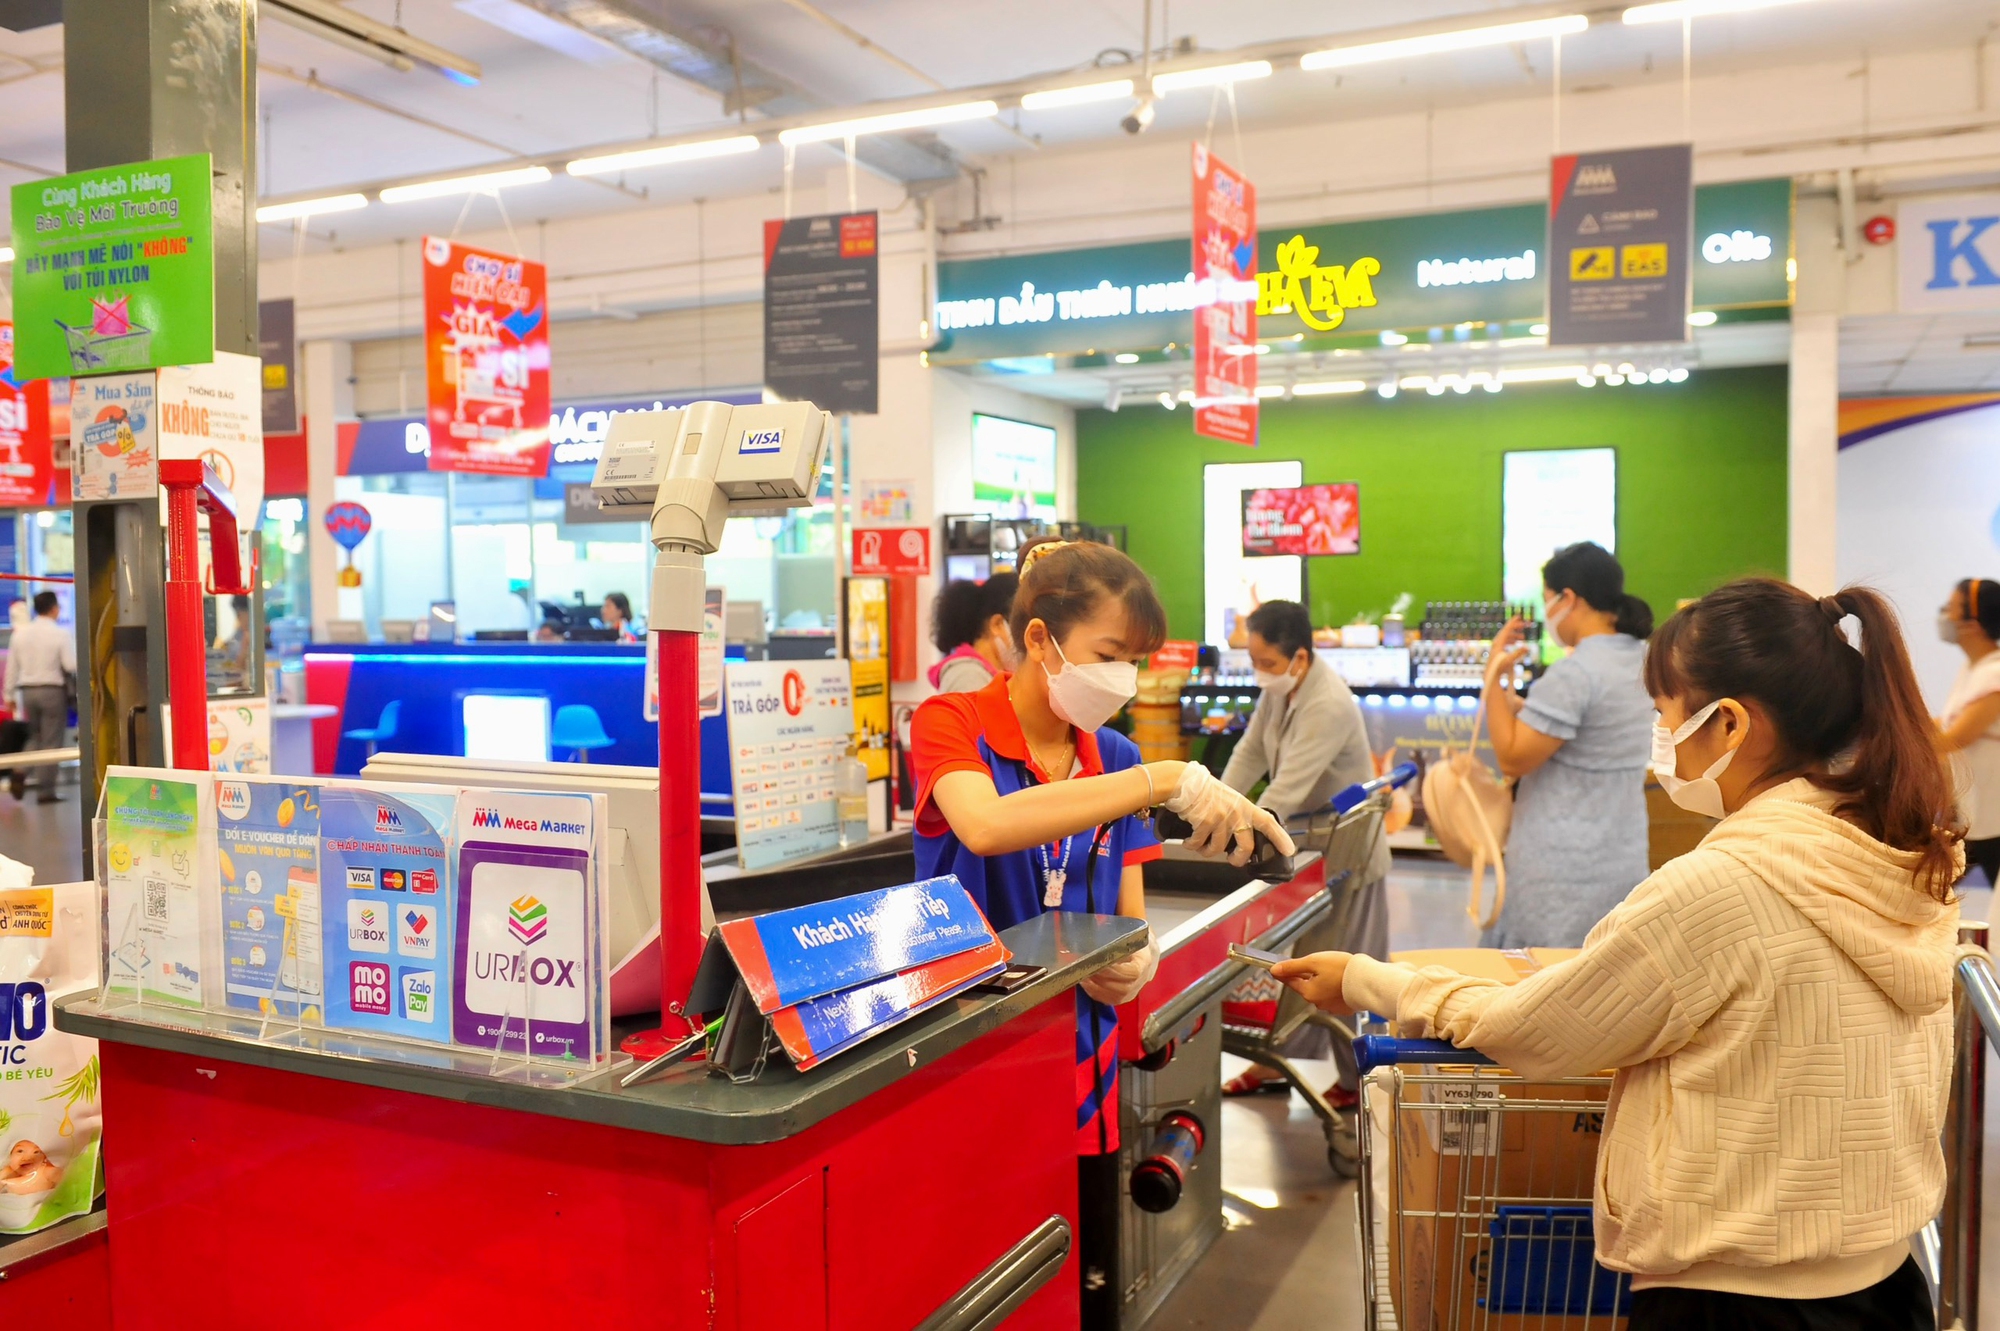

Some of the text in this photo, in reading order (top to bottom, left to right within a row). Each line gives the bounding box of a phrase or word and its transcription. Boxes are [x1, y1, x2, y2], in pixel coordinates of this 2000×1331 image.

[42, 172, 171, 208] Cùng Khách Hàng
[36, 198, 178, 232] Bảo Vệ Môi Trường
[89, 243, 107, 264] MẼ
[112, 241, 133, 261] NÓI
[1417, 229, 1772, 288] Natural Oils
[86, 267, 105, 287] TÚI
[109, 265, 149, 285] NYLON
[95, 380, 151, 400] Mua Sắm
[188, 386, 234, 400] THÔNG BÁO
[162, 399, 209, 437] KHÔNG
[747, 432, 780, 445] VISA
[732, 694, 753, 714] TRẢ
[756, 694, 780, 713] GÓP
[241, 831, 285, 844] E-VOUCHER
[327, 836, 358, 852] CHẤP
[361, 840, 389, 856] NHẬN
[391, 843, 421, 856] THANH
[351, 872, 372, 883] VISA
[422, 873, 434, 881] Card
[13, 919, 30, 929] ANH
[31, 918, 47, 930] QUỐC
[350, 928, 386, 942] URBOX
[404, 936, 431, 947] VNPAY
[792, 917, 853, 950] Khách
[409, 979, 431, 994] Zalo
[409, 995, 428, 1012] Pay
[822, 1000, 844, 1021] Next
[505, 1030, 518, 1039] 299
[6, 1067, 53, 1081] BÉ YÊU
